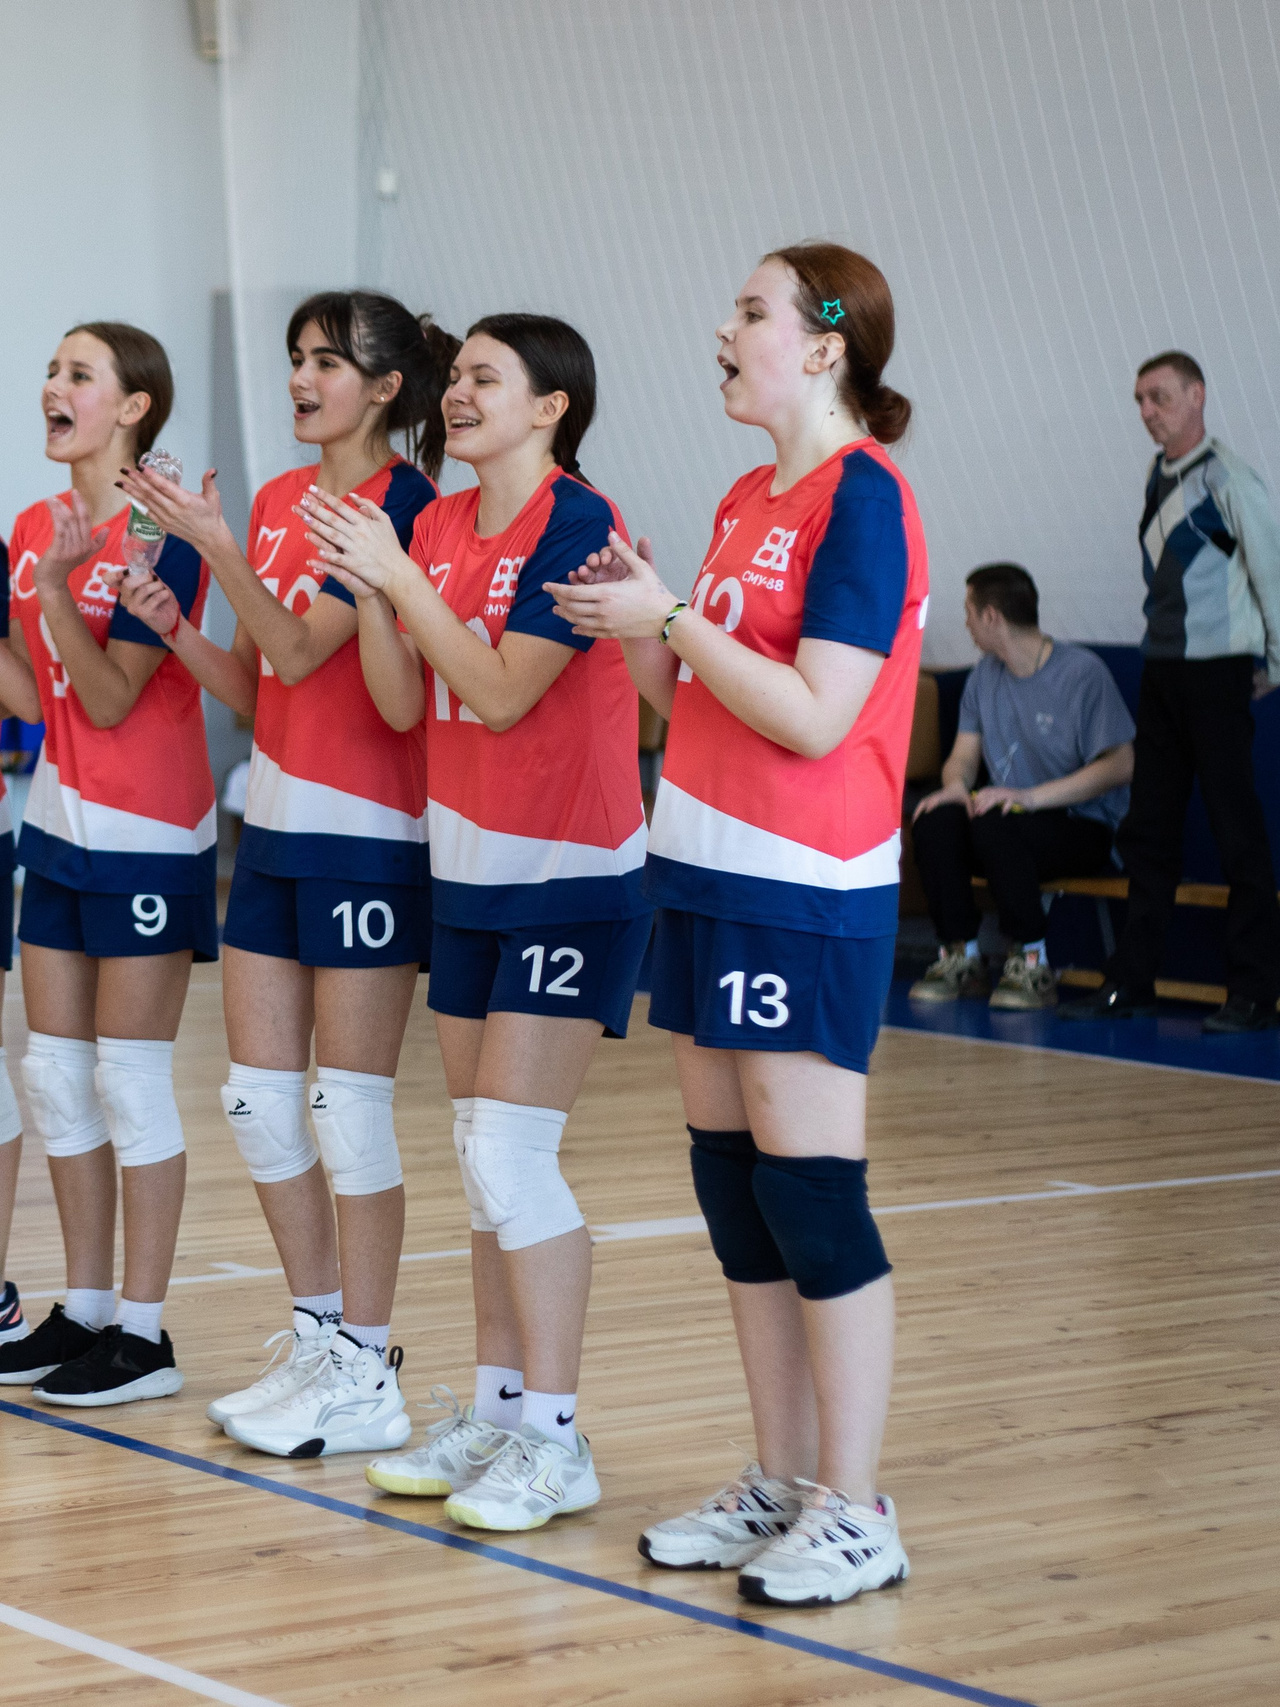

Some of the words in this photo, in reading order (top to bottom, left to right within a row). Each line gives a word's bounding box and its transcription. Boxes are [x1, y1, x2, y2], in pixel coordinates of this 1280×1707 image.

[131, 894, 168, 936] 9
[332, 900, 395, 949] 10
[522, 944, 584, 997] 12
[719, 970, 789, 1029] 13
